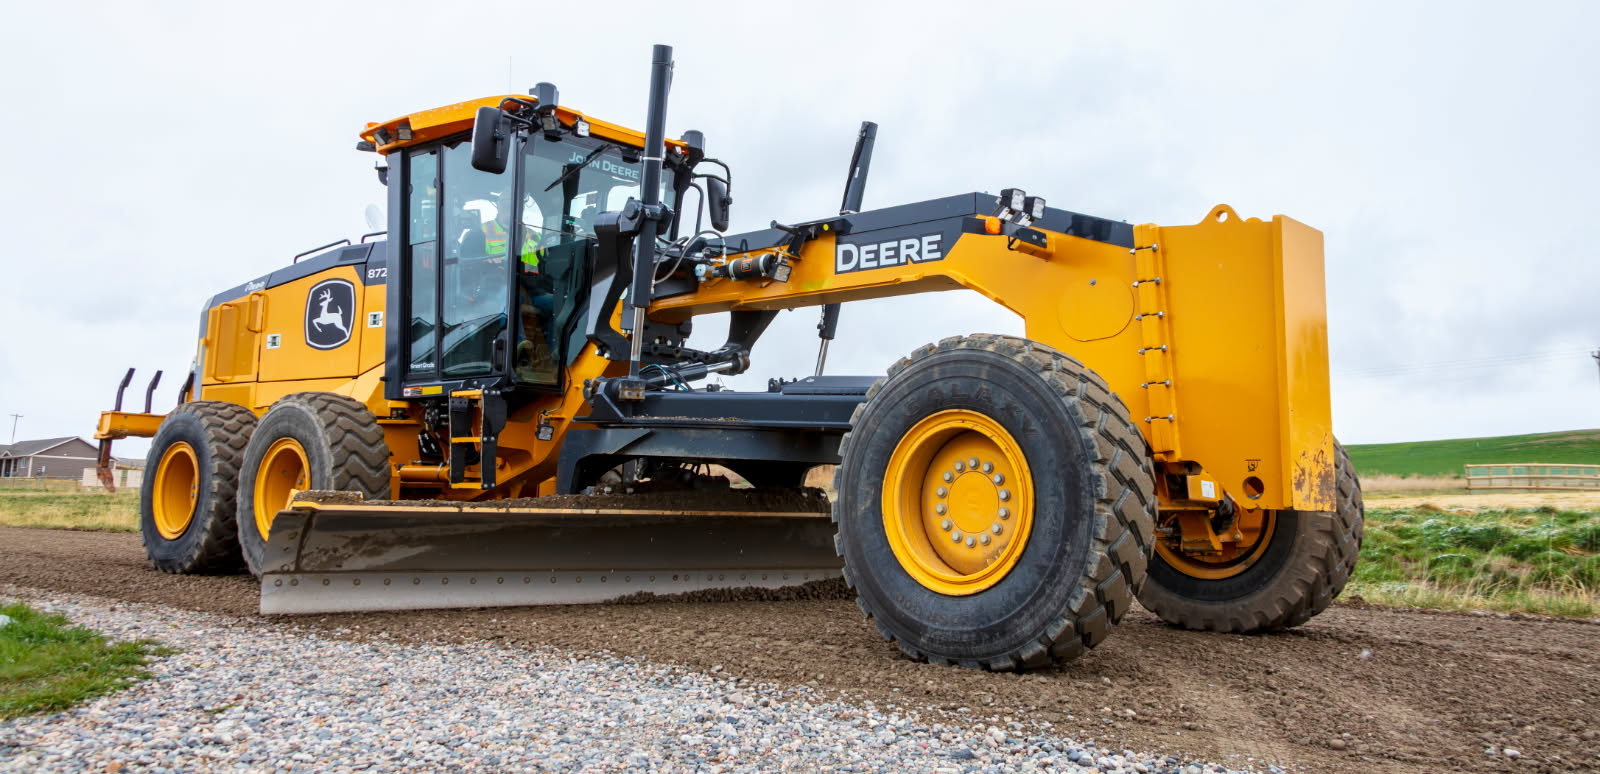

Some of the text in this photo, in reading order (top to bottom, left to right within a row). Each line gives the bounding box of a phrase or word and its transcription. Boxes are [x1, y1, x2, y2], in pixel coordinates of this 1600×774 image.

[602, 160, 639, 179] DEERE
[836, 234, 941, 272] DEERE
[367, 267, 387, 279] 872
